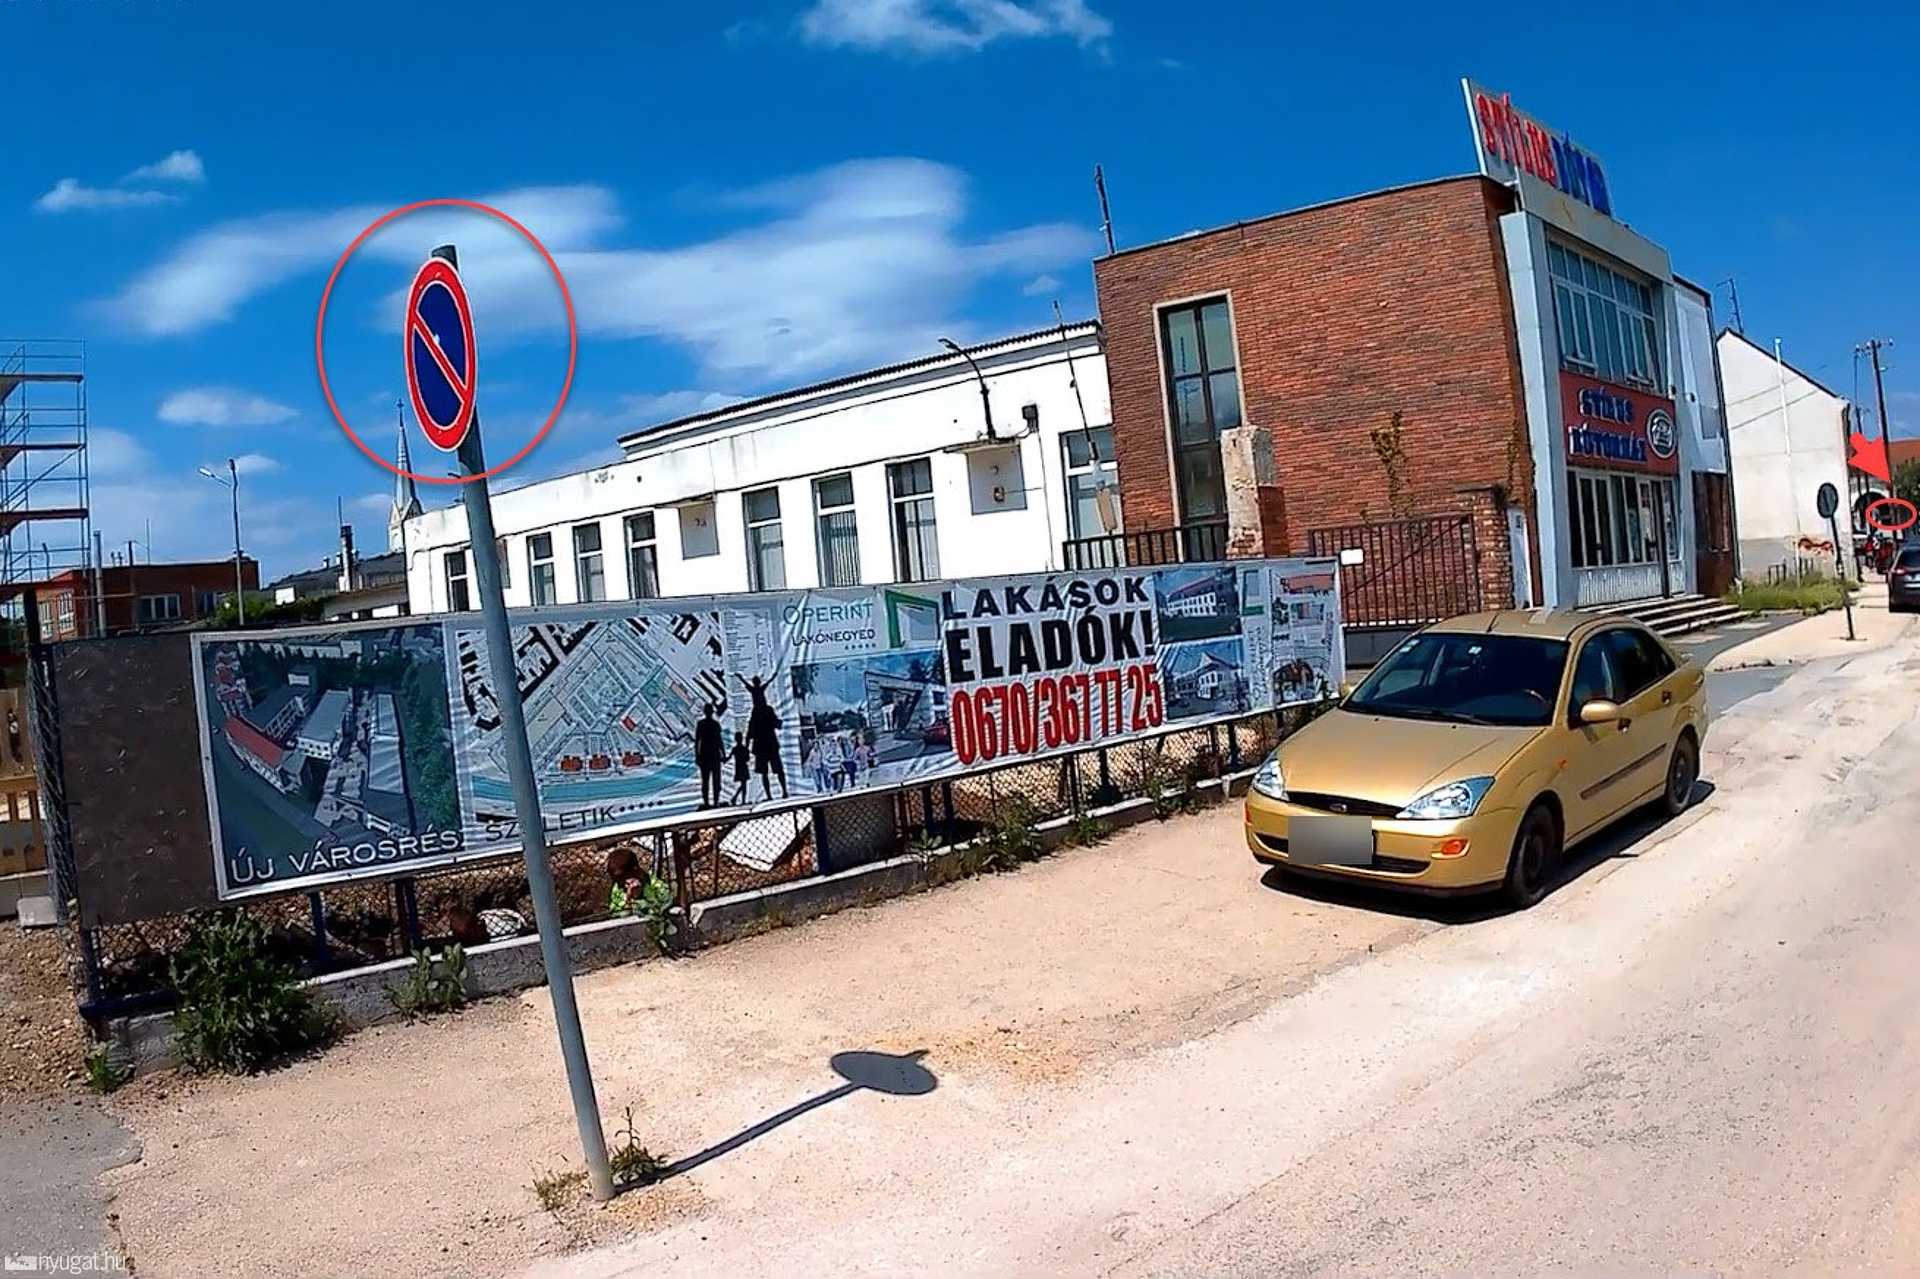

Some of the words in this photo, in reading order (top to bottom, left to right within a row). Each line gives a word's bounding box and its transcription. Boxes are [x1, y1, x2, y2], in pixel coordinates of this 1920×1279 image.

[783, 599, 874, 625] ÓPERINT
[942, 577, 1150, 621] LAKÁSOK
[792, 629, 876, 647] LAKÓNEGYED
[947, 606, 1156, 683] ELADÓK!
[952, 674, 1092, 765] 0670/367
[231, 847, 274, 884] ÚJ
